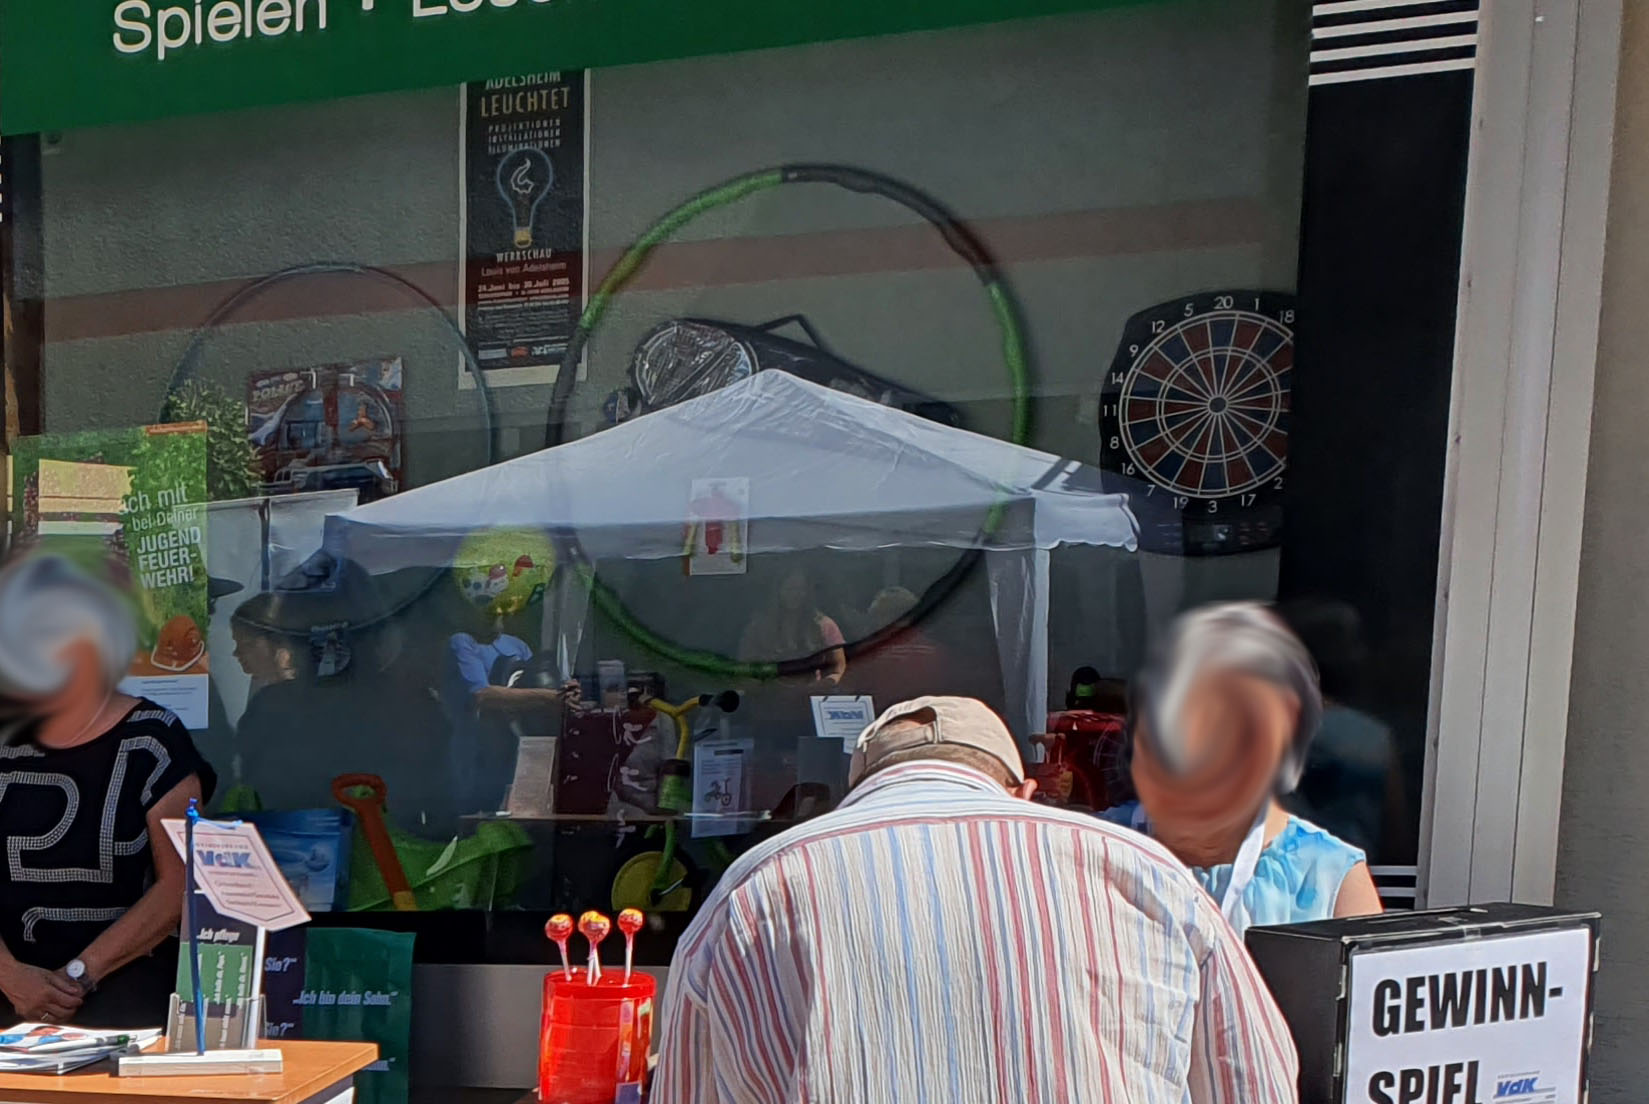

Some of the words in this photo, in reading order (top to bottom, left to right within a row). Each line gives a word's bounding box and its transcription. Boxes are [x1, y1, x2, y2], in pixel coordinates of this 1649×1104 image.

[113, 0, 328, 60] Spielen
[481, 86, 570, 117] LEUCHTET
[496, 248, 553, 263] WERKSCHAU
[1184, 303, 1194, 317] 5
[1213, 296, 1234, 310] 20
[1254, 298, 1260, 311] 1
[1279, 310, 1295, 324] 18
[1152, 320, 1165, 333] 12
[1129, 344, 1139, 358] 9
[1111, 372, 1124, 385] 14
[1103, 404, 1117, 417] 11
[1110, 436, 1119, 449] 8
[1121, 463, 1135, 476] 16
[1274, 476, 1283, 490] 2
[158, 481, 189, 508] mit
[1147, 484, 1156, 497] 7
[1173, 496, 1189, 510] 19
[1207, 500, 1218, 514] 3
[1241, 494, 1257, 507] 17
[132, 513, 153, 531] bei
[156, 506, 198, 527] Deiner
[137, 526, 201, 554] JUGEND
[138, 547, 197, 571] FEUER-
[140, 565, 195, 590] WEHR!
[197, 850, 252, 869] VdK
[1372, 961, 1563, 1037] GEWINN-
[1496, 1077, 1538, 1097] VdK
